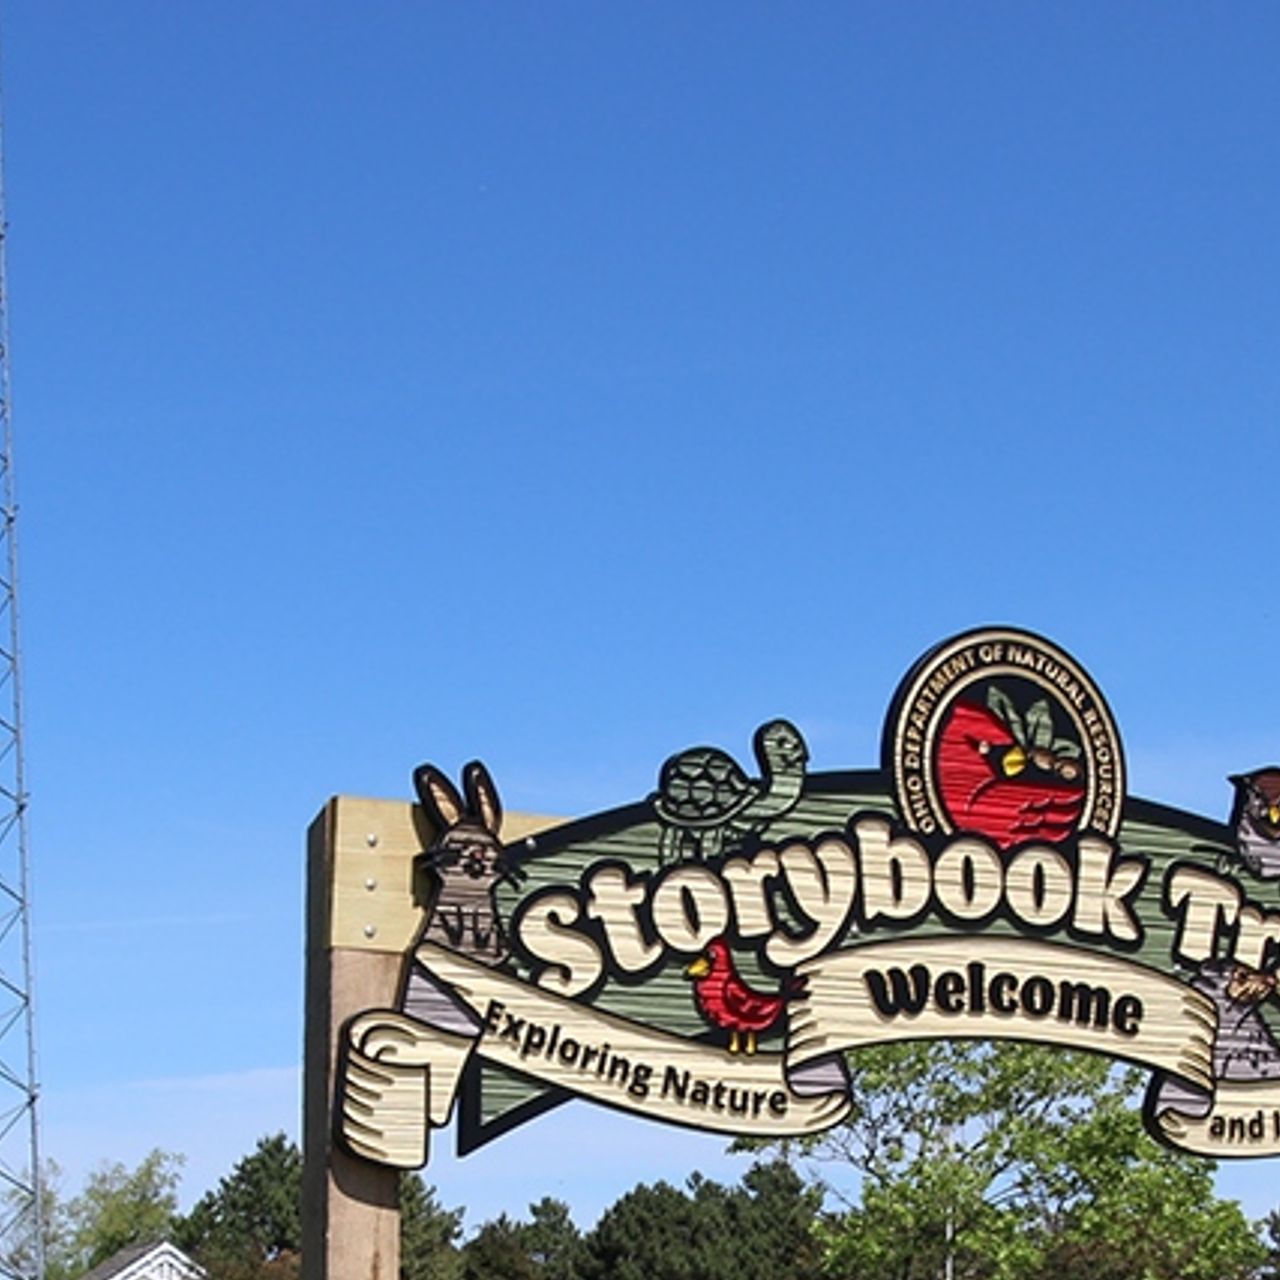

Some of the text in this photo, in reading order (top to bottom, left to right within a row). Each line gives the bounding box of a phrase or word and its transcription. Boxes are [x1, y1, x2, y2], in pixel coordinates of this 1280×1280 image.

[905, 645, 1113, 834] OHIO DEPARTMENT OF NATURAL RESOURCES
[519, 818, 1148, 998] Storybook
[863, 960, 1144, 1037] Welcome
[484, 999, 789, 1116] Exploring Nature
[1209, 1108, 1265, 1141] and
